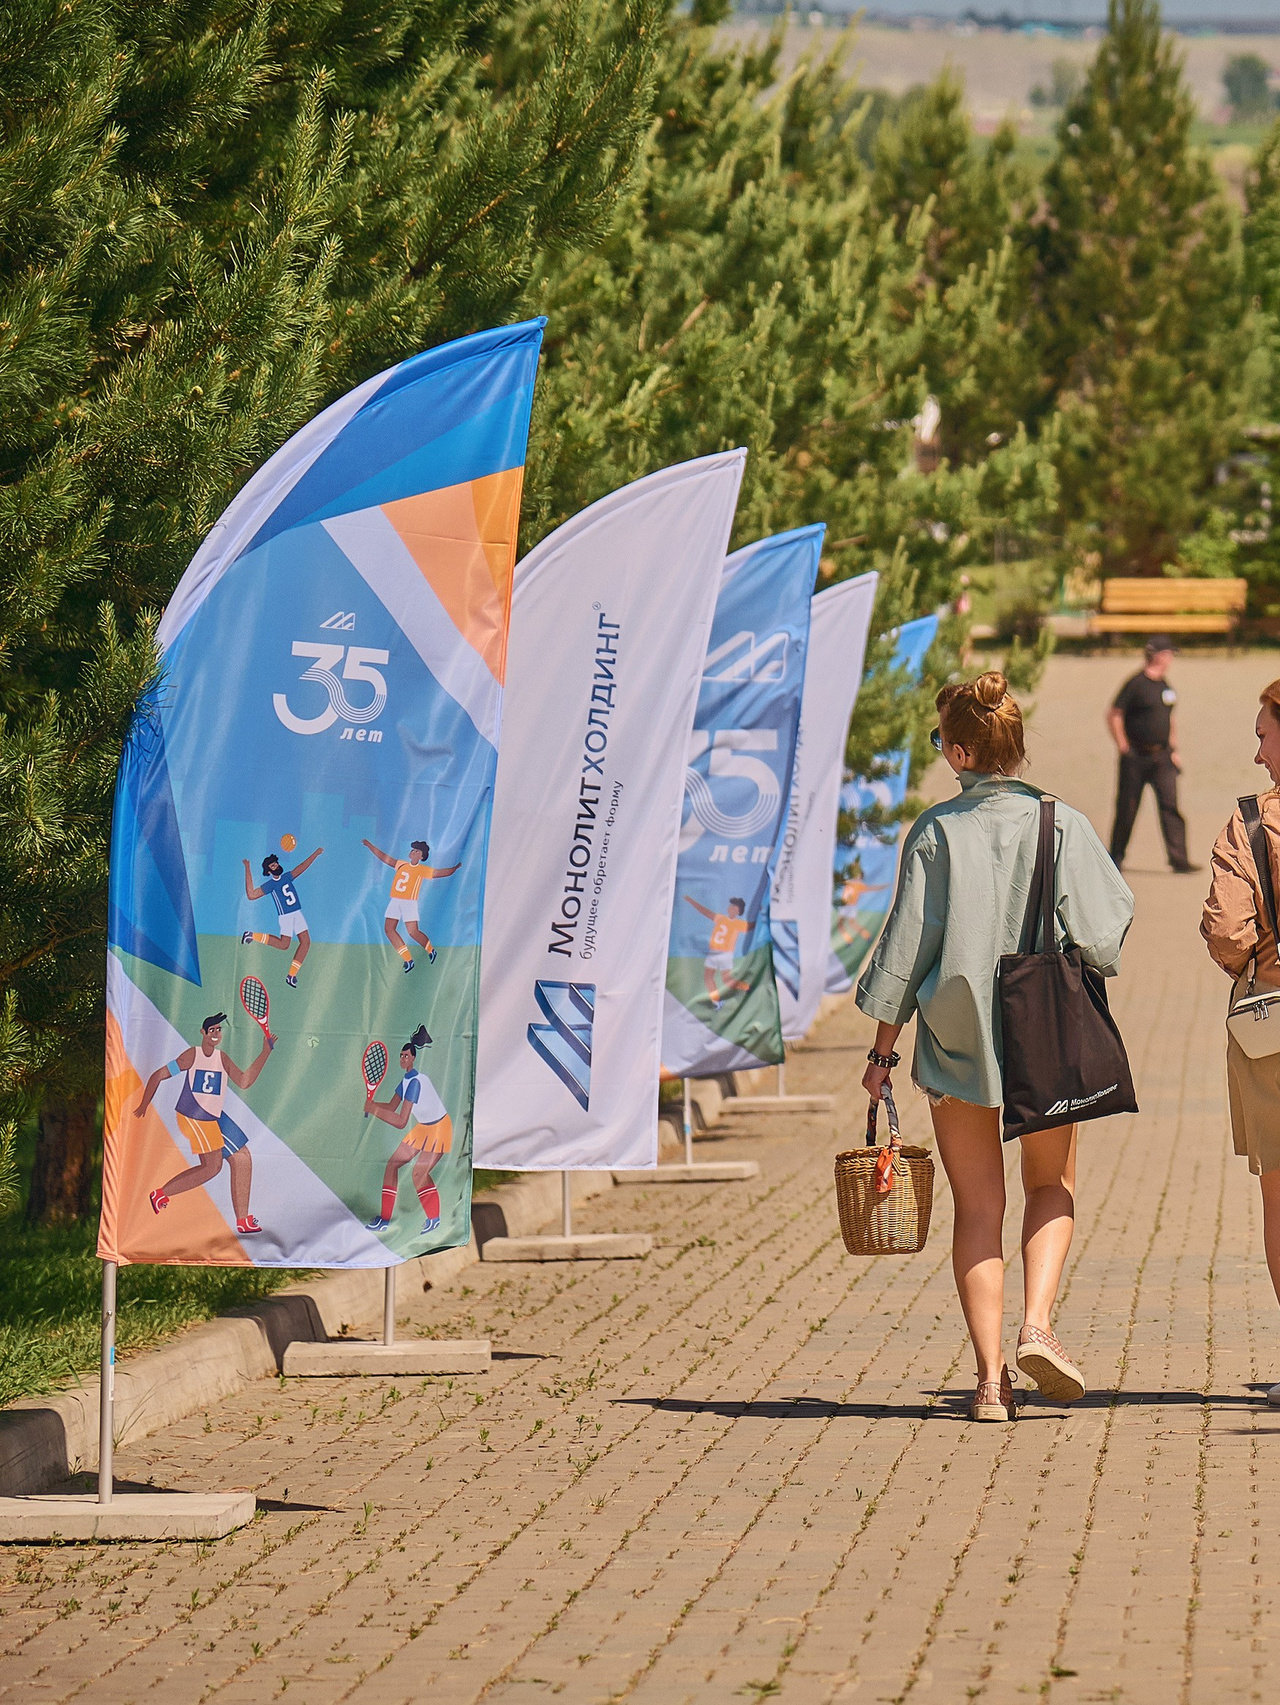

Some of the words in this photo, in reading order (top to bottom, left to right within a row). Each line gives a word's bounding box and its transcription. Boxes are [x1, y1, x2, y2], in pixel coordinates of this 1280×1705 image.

[273, 641, 389, 735] 35
[340, 727, 382, 743] лет
[395, 871, 410, 892] 2
[580, 898, 602, 960] будущее
[591, 830, 611, 895] обретает
[605, 780, 623, 827] форму
[282, 883, 296, 906] 5
